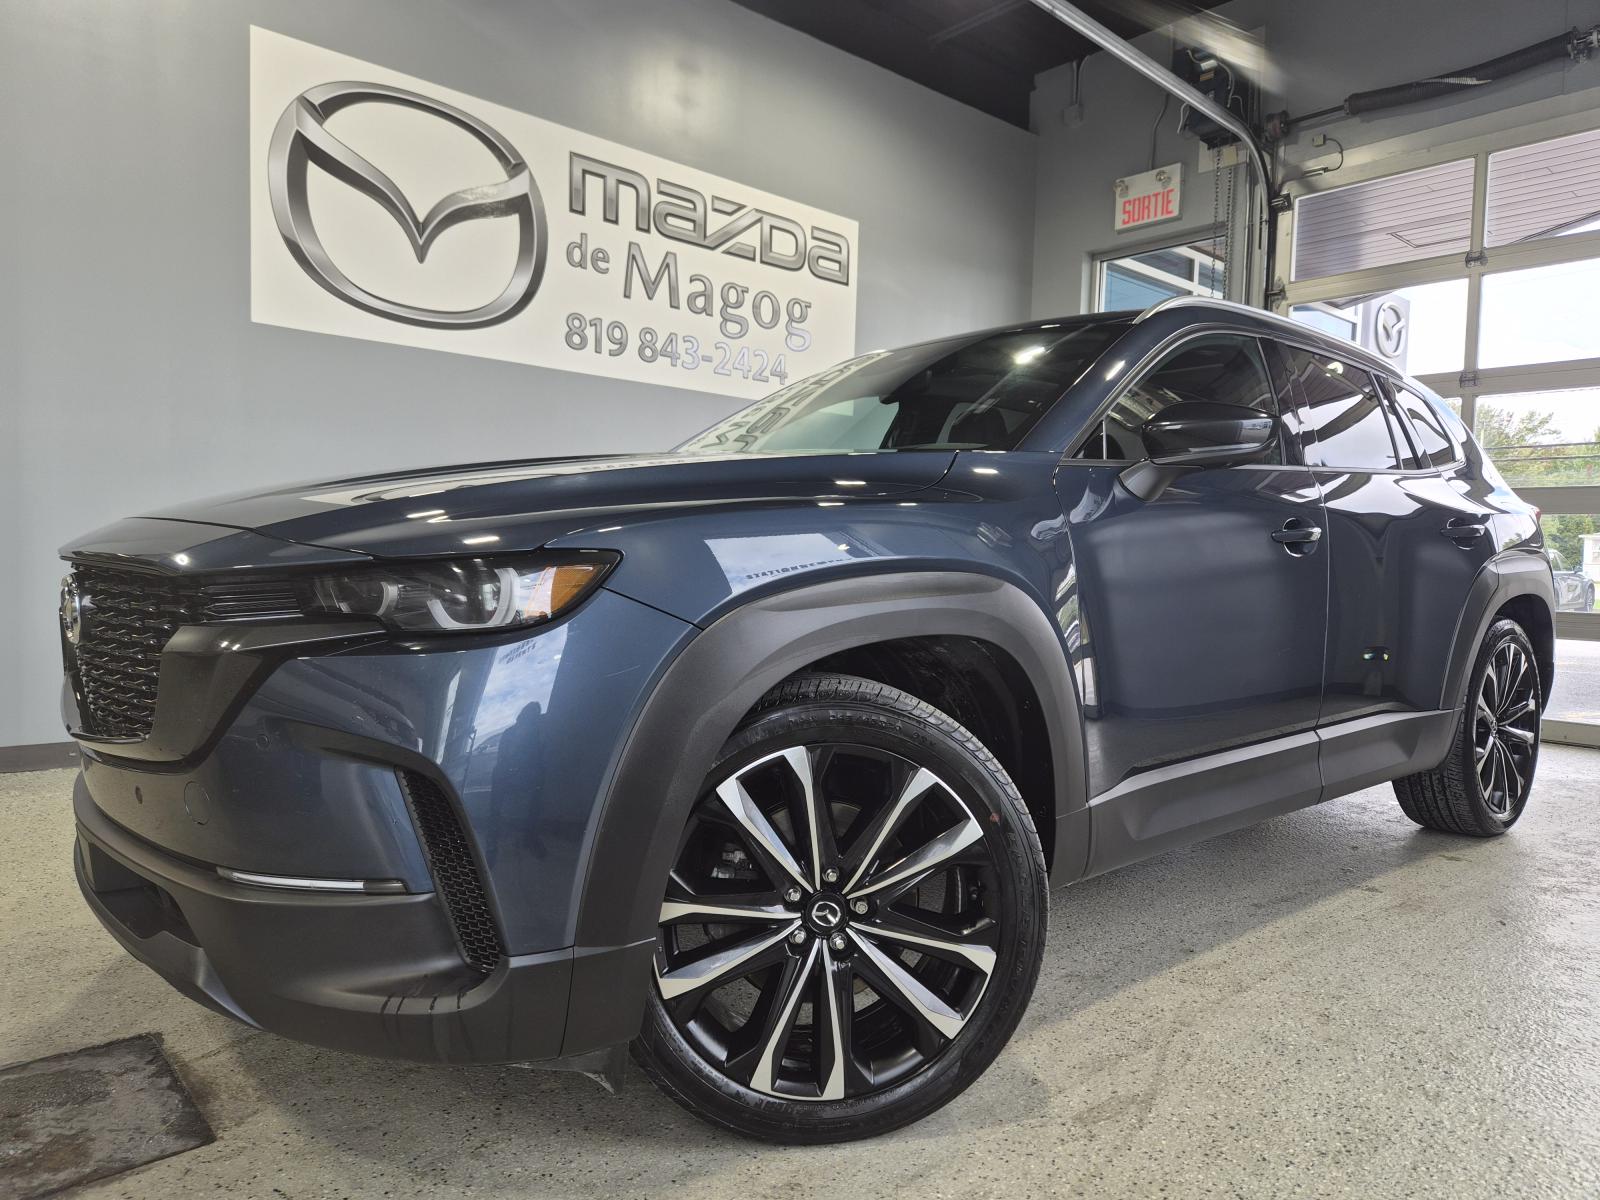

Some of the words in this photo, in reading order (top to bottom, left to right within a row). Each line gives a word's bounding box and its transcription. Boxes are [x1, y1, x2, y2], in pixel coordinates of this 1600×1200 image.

[1122, 188, 1174, 225] SORTIE
[566, 232, 610, 274] de
[623, 241, 811, 352] Magog
[565, 312, 628, 356] 819
[638, 327, 788, 385] 843-2424
